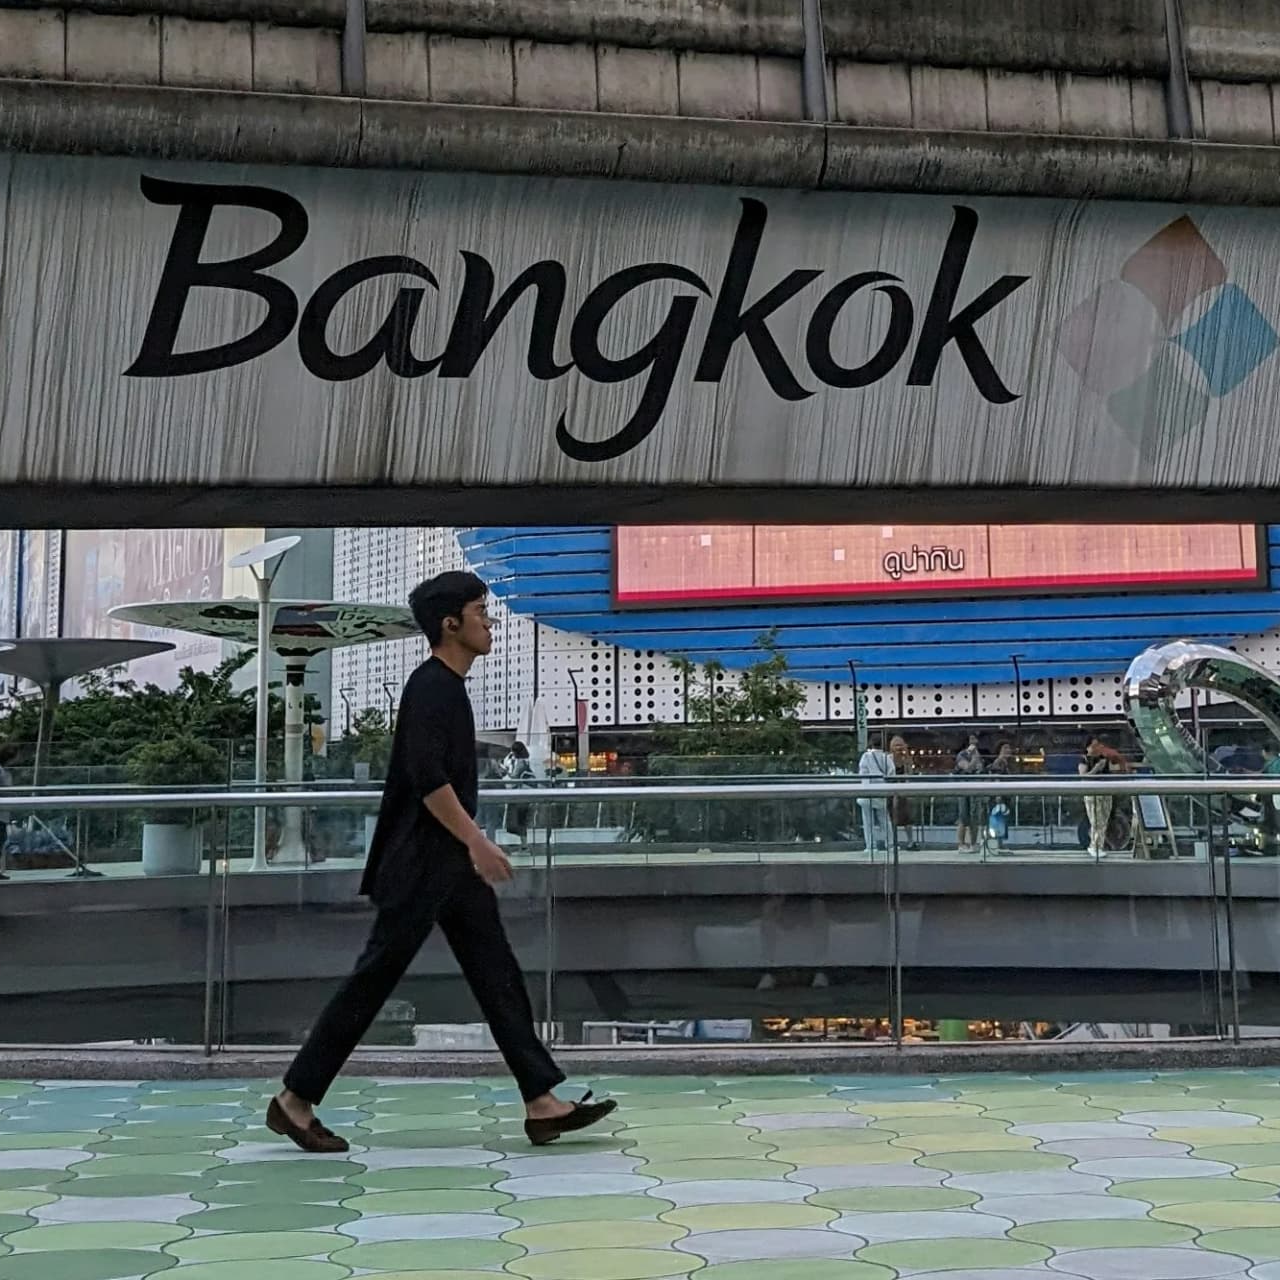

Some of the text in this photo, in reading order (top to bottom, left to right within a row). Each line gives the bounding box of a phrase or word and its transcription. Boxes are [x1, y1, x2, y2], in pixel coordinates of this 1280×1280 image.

[122, 174, 1031, 463] Bangkok
[883, 544, 965, 580] ดูน่ากิน
